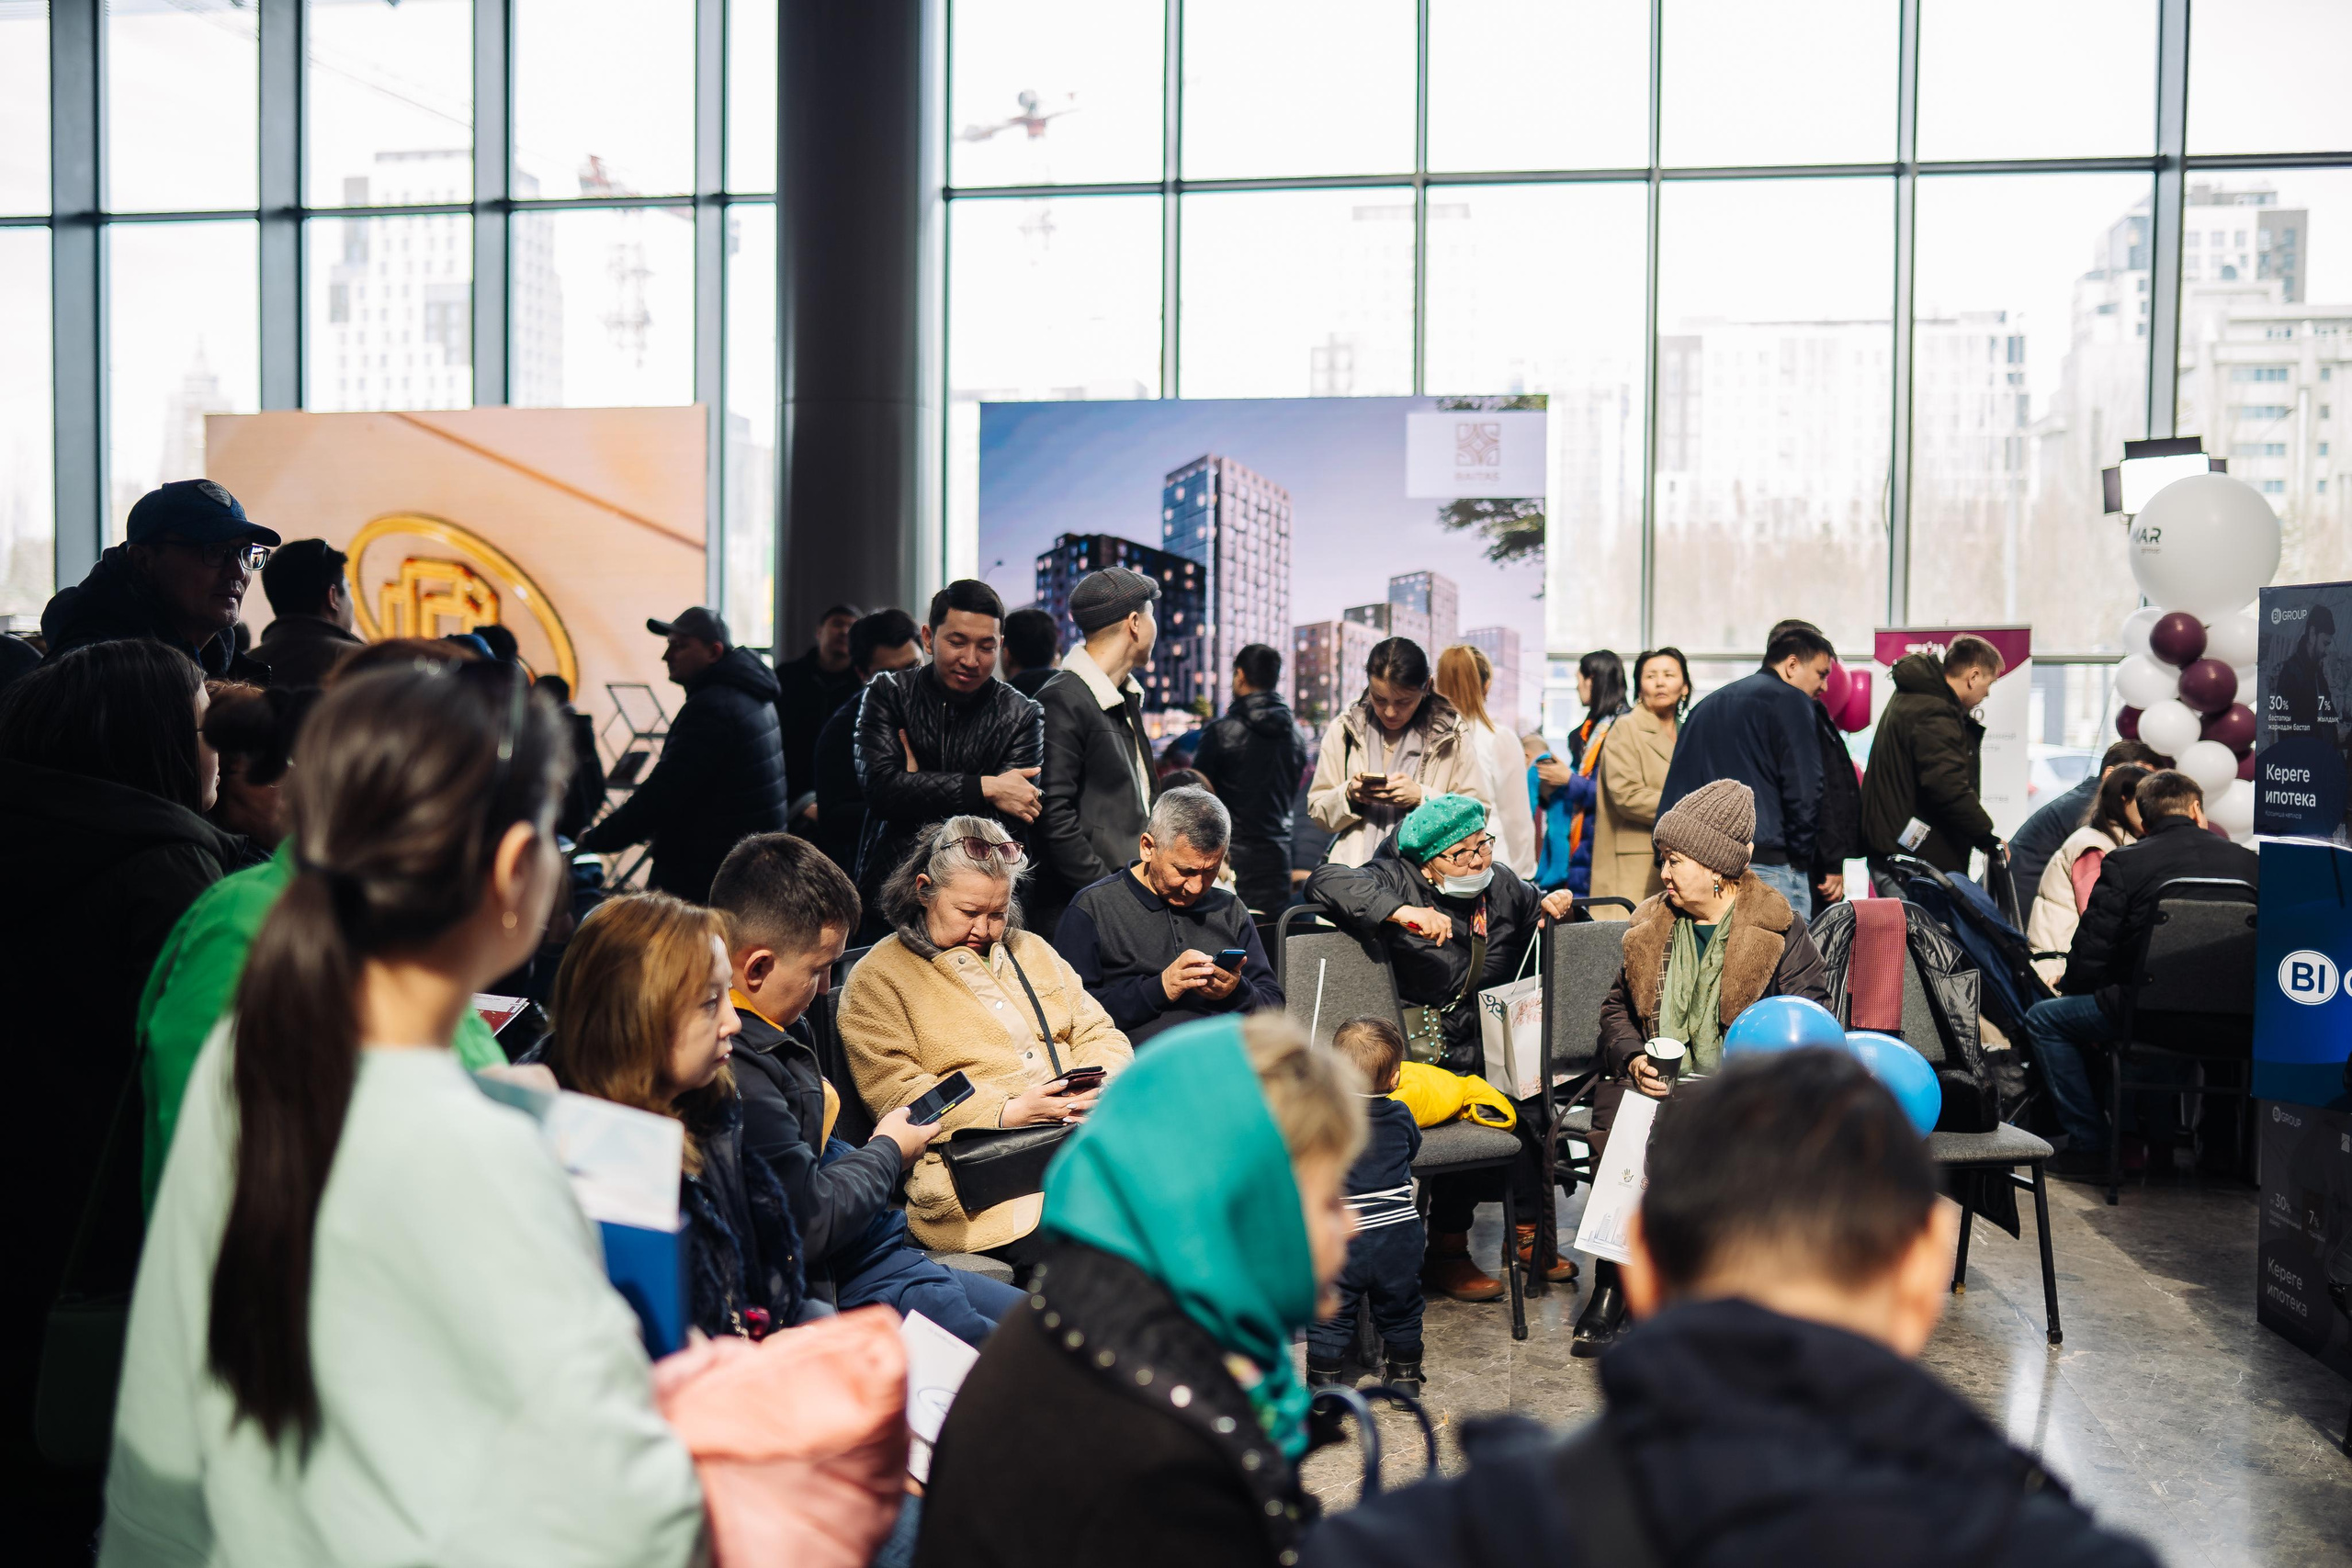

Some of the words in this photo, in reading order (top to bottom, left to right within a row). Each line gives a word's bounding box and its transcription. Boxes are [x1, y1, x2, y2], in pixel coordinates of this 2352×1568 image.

[2282, 609, 2308, 621] GROUP
[2268, 694, 2290, 710] 30%
[2318, 695, 2332, 711] 7%
[2266, 763, 2311, 784] Кереге
[2265, 790, 2316, 807] ипотека
[2290, 961, 2326, 995] BI
[2280, 1111, 2301, 1128] GROUP
[2275, 1192, 2291, 1213] 30%
[2309, 1209, 2319, 1228] 7%
[2267, 1257, 2302, 1291] Кереге
[2267, 1282, 2308, 1317] ипотека
